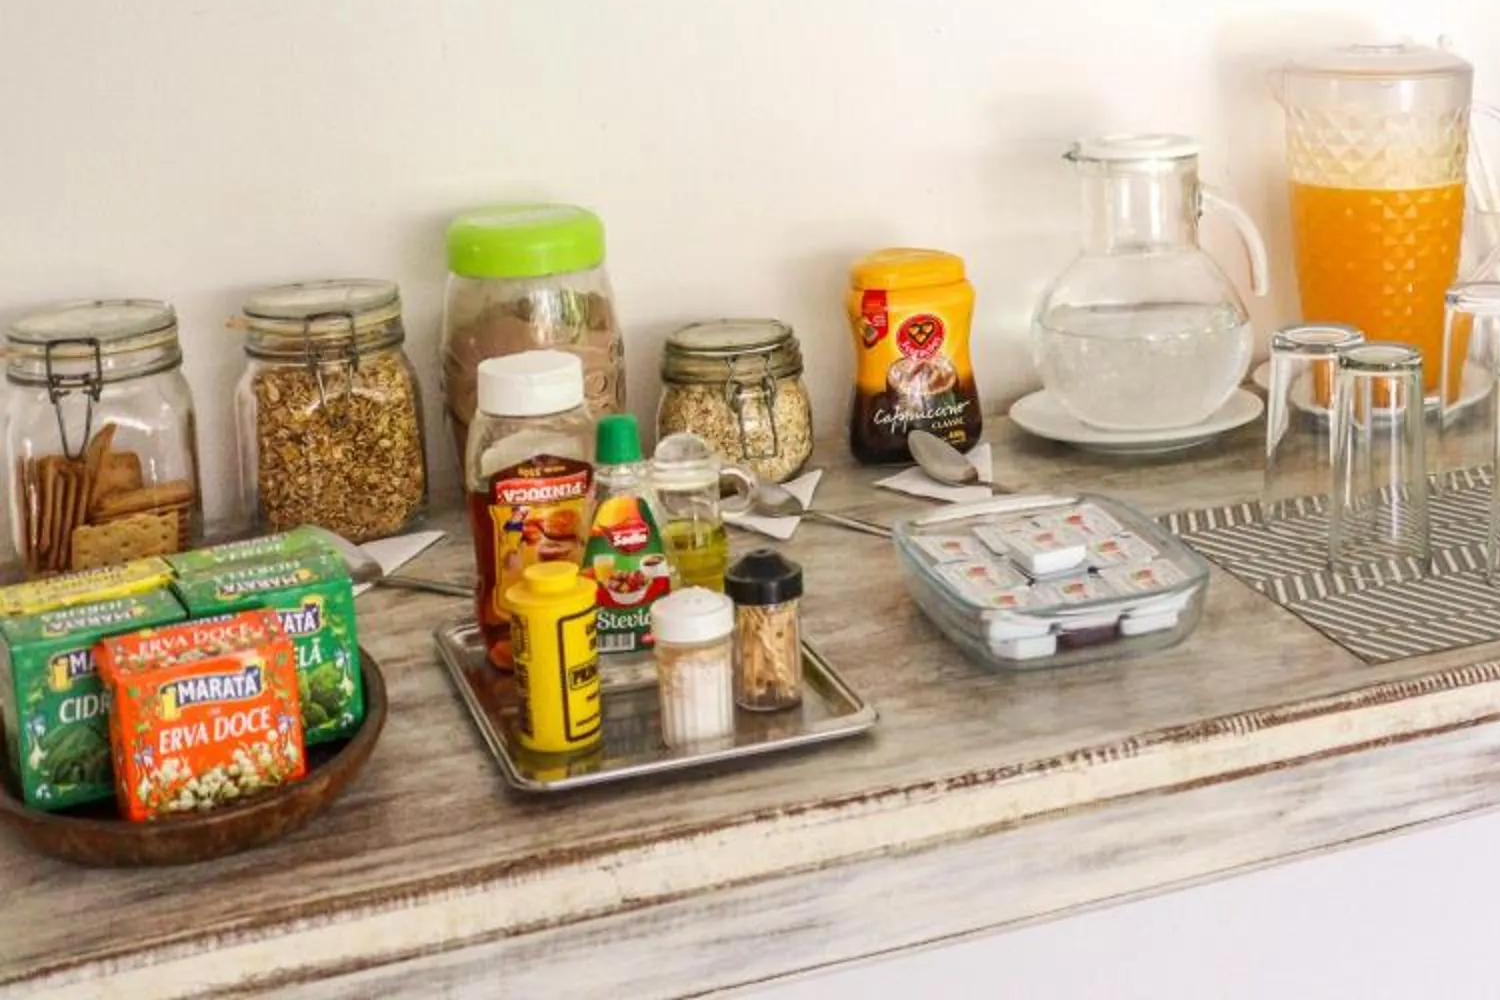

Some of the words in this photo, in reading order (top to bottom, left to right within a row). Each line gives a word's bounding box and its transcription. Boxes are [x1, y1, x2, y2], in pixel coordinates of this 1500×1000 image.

[502, 481, 582, 503] PINDUCA
[139, 634, 189, 655] ERVA
[194, 623, 250, 646] DOCE
[159, 722, 208, 754] ERVA
[214, 706, 271, 741] DOCE
